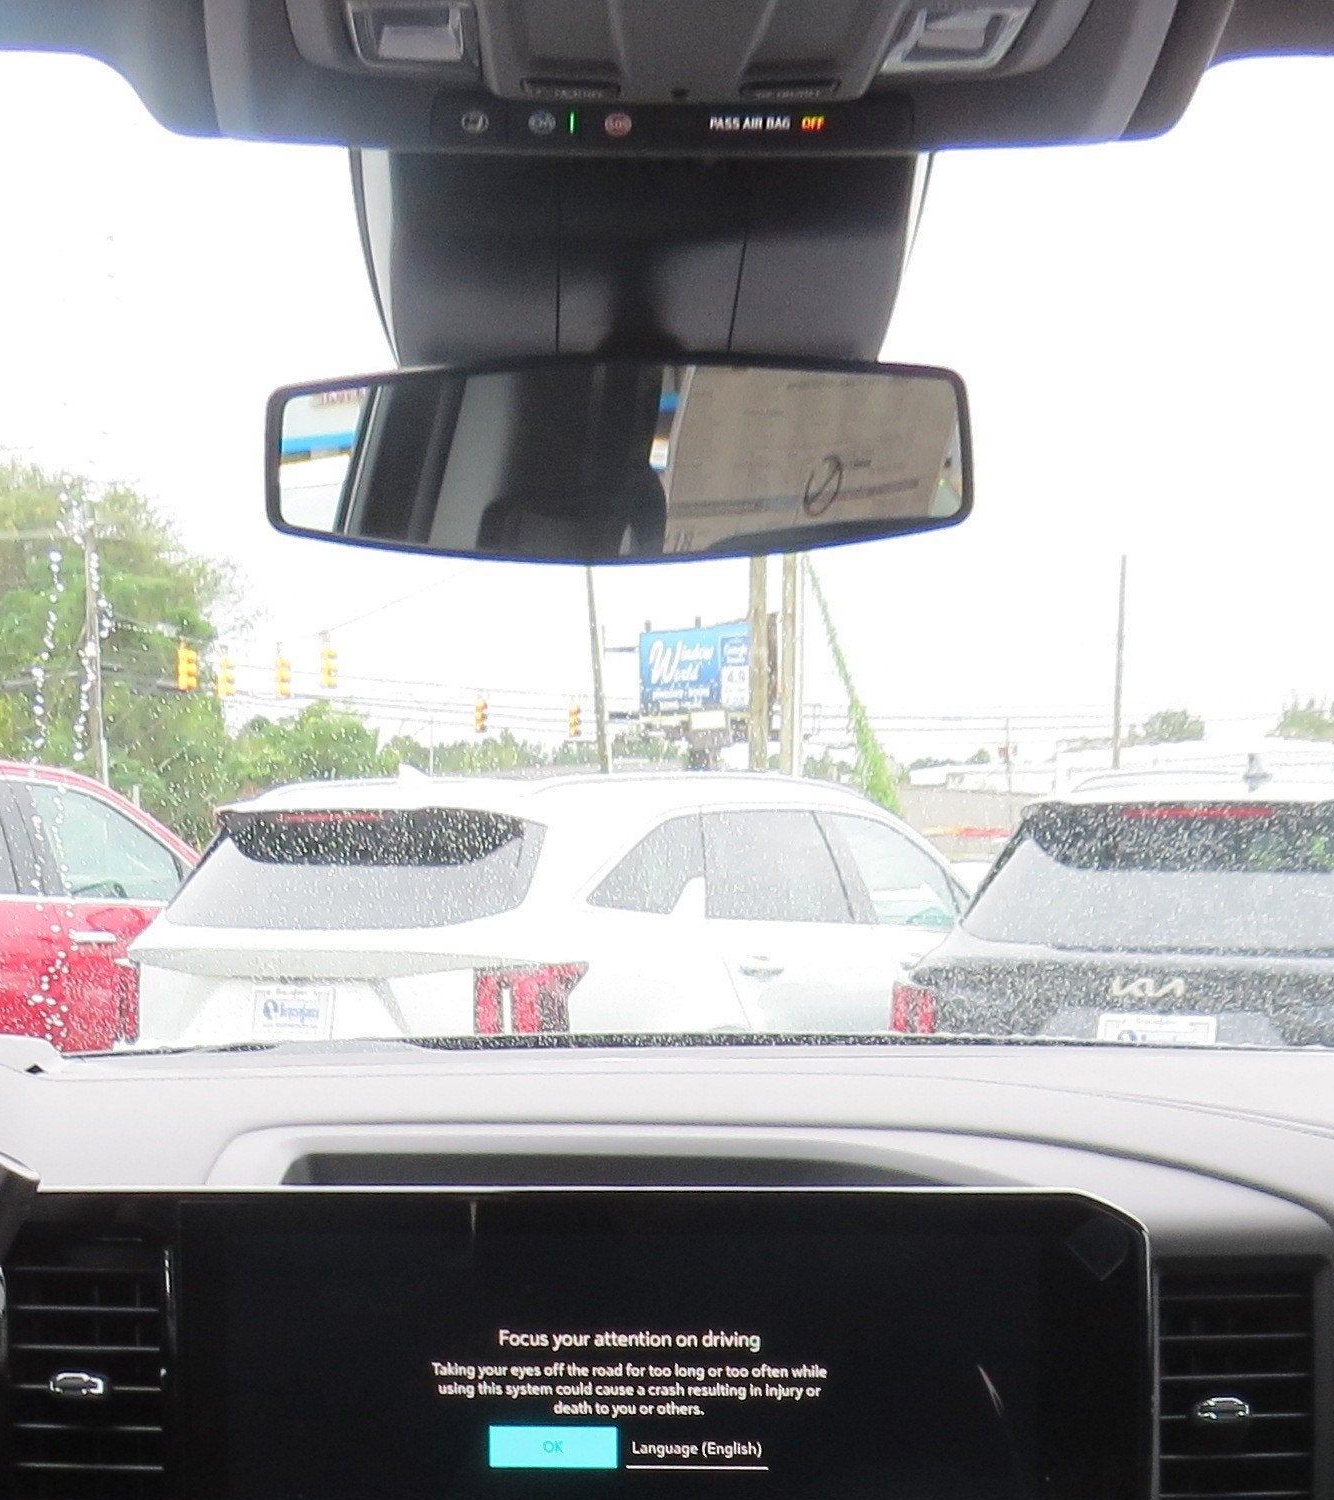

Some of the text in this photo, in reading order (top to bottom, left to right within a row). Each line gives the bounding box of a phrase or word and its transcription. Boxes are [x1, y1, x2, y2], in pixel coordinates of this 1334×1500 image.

[709, 115, 826, 131] PASS AIR BAG OFF
[498, 1329, 761, 1353] Focus your attention on driving
[431, 1361, 828, 1382] Taking your eyes off the road for too long or too often while
[437, 1381, 822, 1401] using this system could cause a crash resulting in injury or
[553, 1400, 705, 1419] death to you or others.
[542, 1440, 763, 1459] OK Language (English)
